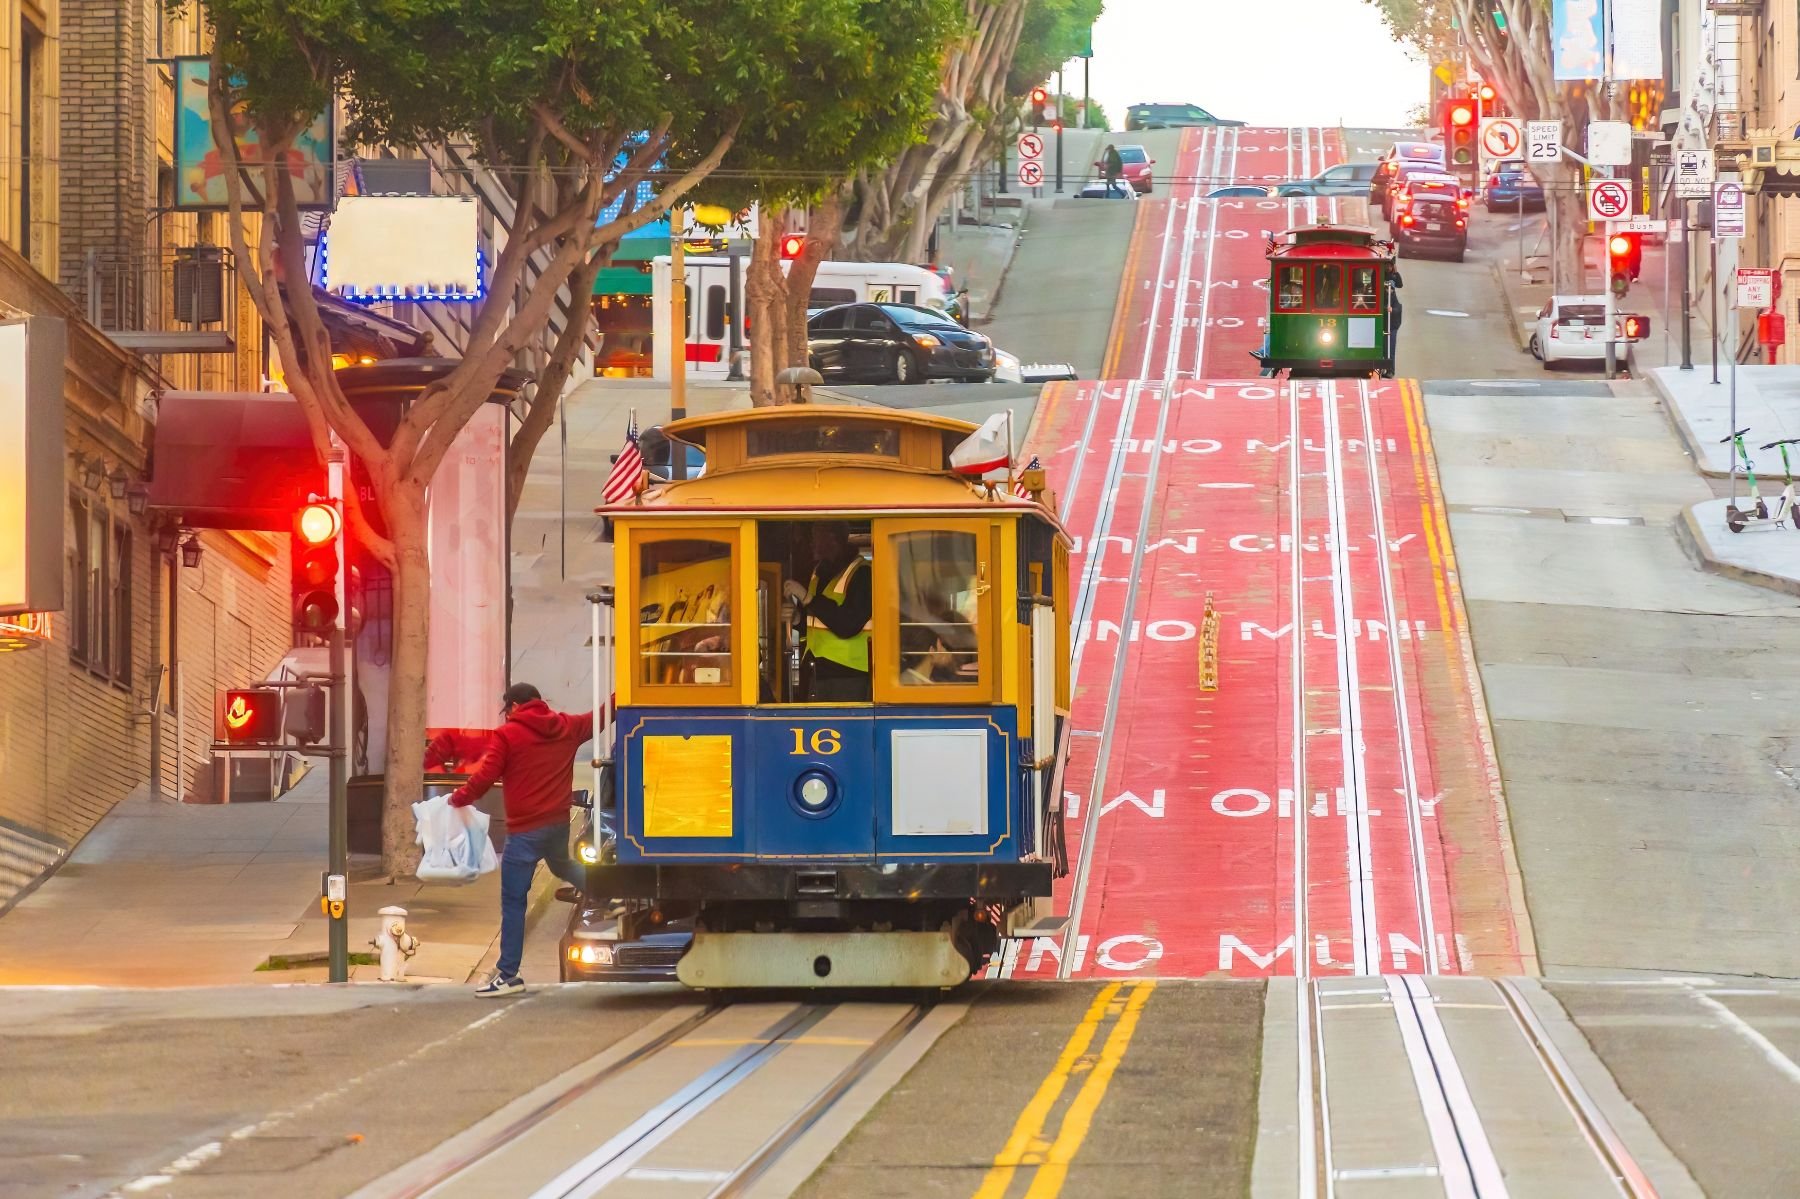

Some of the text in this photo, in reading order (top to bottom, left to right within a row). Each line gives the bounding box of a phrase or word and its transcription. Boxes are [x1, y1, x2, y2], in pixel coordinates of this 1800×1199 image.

[1531, 125, 1558, 133] SPEED
[1532, 142, 1558, 158] 25
[1238, 386, 1393, 400] ONLY
[1246, 438, 1397, 453] MUNI
[1228, 533, 1417, 553] ONLY
[1070, 619, 1197, 642] ONL
[1240, 619, 1427, 641] MUNI
[789, 728, 842, 755] 16
[1210, 787, 1452, 818] ONLY
[1218, 932, 1475, 972] MUNI
